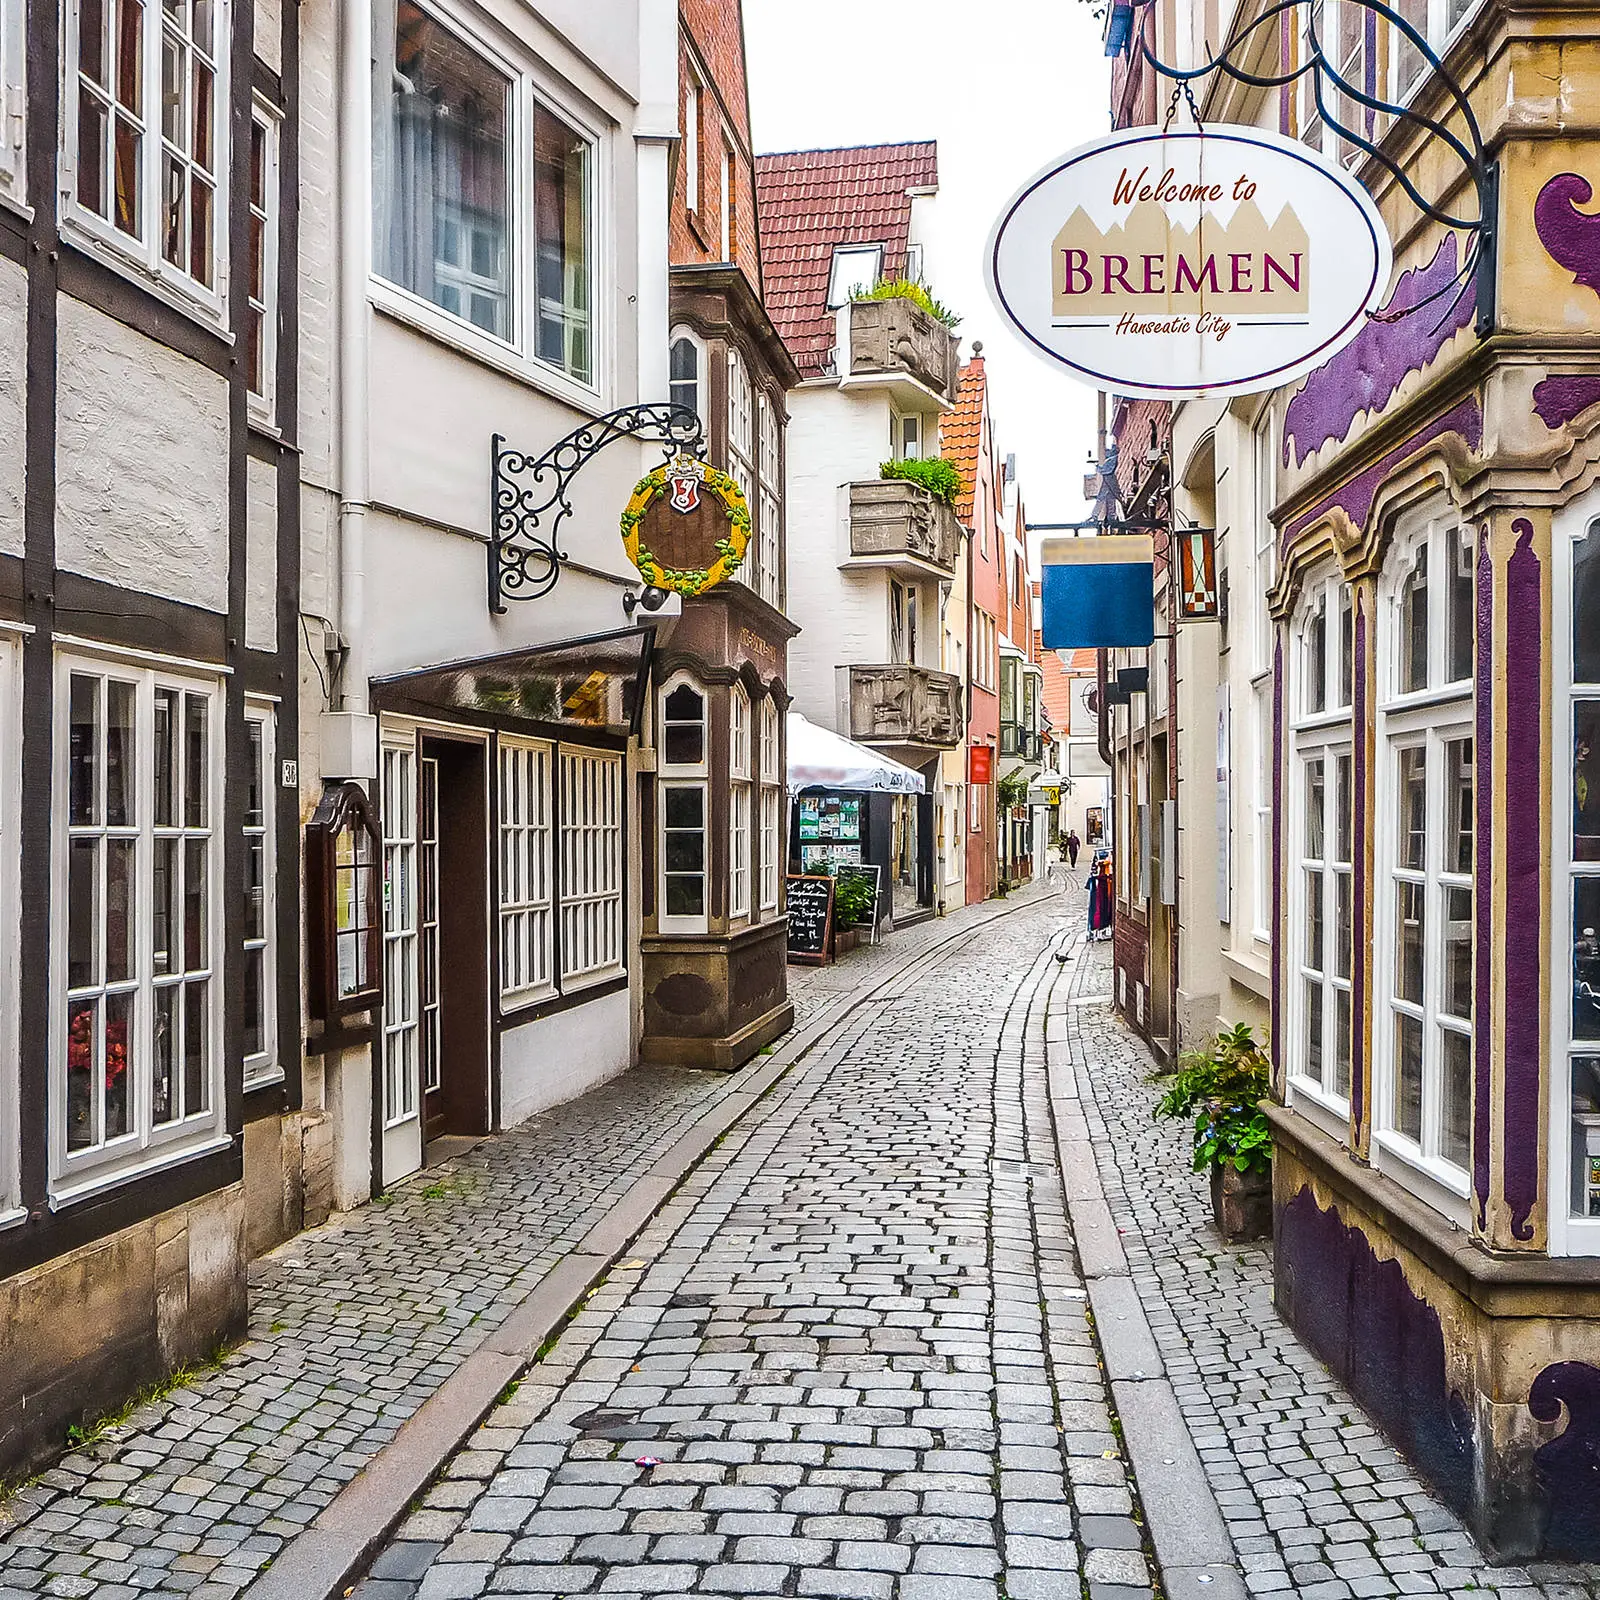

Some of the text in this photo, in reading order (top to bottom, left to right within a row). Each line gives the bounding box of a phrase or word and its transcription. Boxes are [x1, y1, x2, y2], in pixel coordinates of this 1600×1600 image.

[1112, 166, 1257, 206] Welcome to
[1060, 248, 1303, 295] BREMEN
[1116, 311, 1231, 342] Hanseatic City
